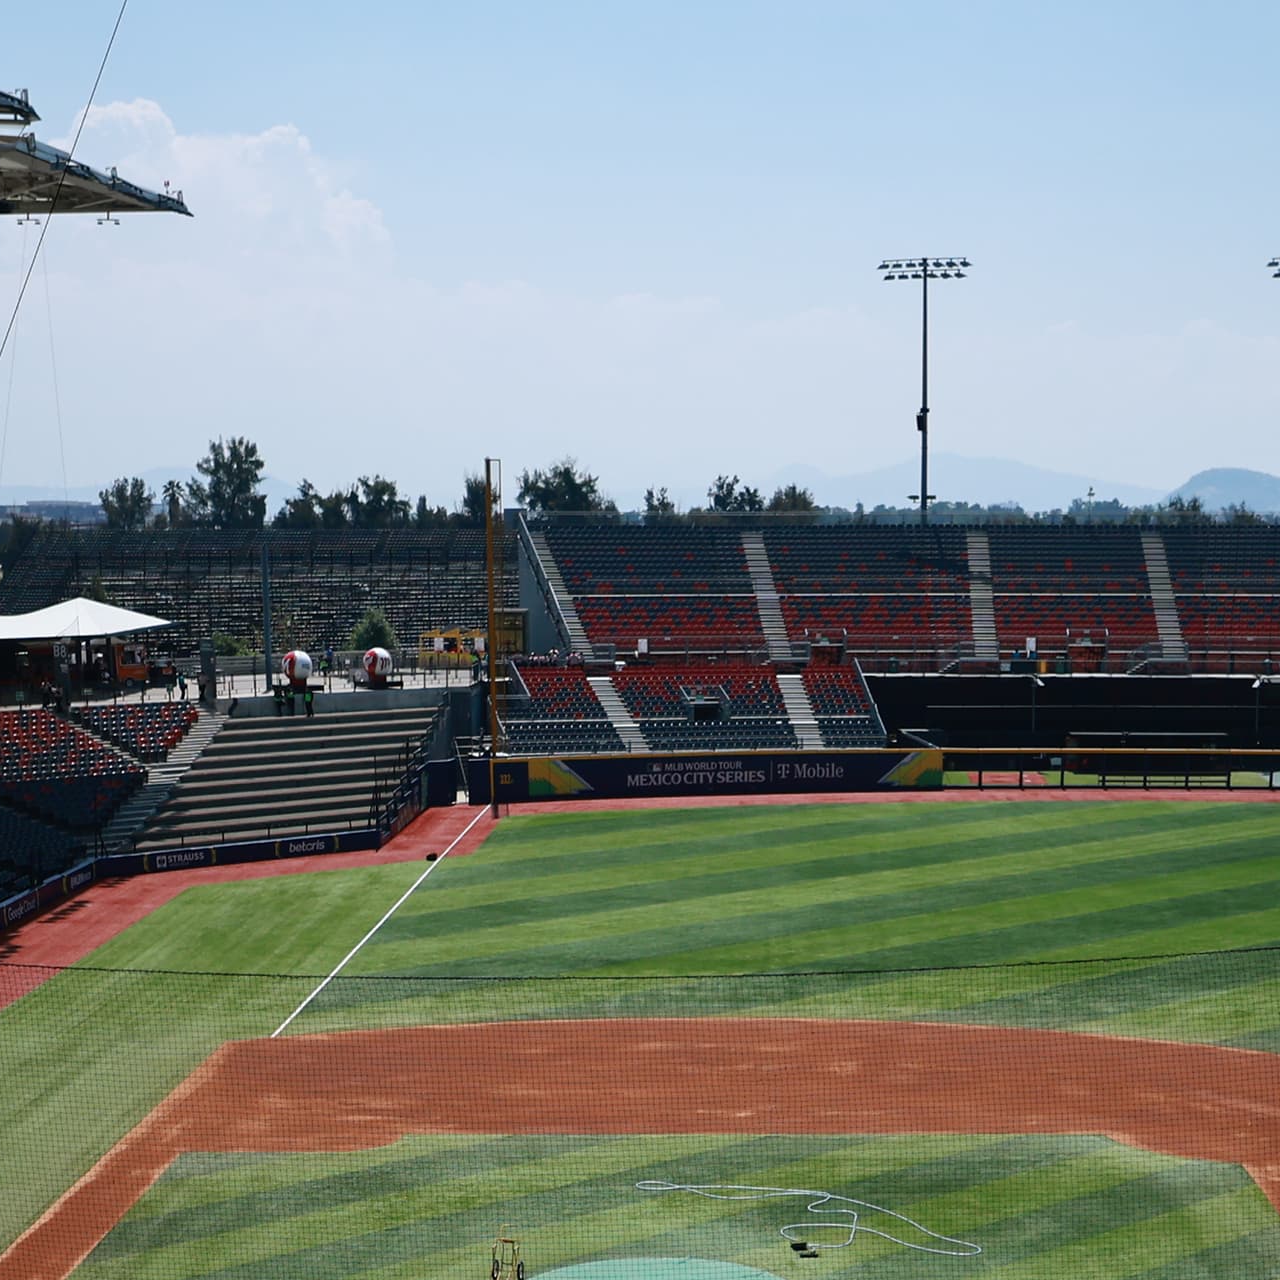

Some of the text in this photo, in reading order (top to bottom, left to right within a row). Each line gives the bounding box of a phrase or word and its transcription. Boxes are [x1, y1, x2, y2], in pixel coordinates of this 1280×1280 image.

[52, 645, 68, 659] B8
[665, 760, 743, 772] MLB WORLD TOUR
[794, 762, 845, 779] Mobile
[627, 770, 766, 787] MEXICO CITY SERIES
